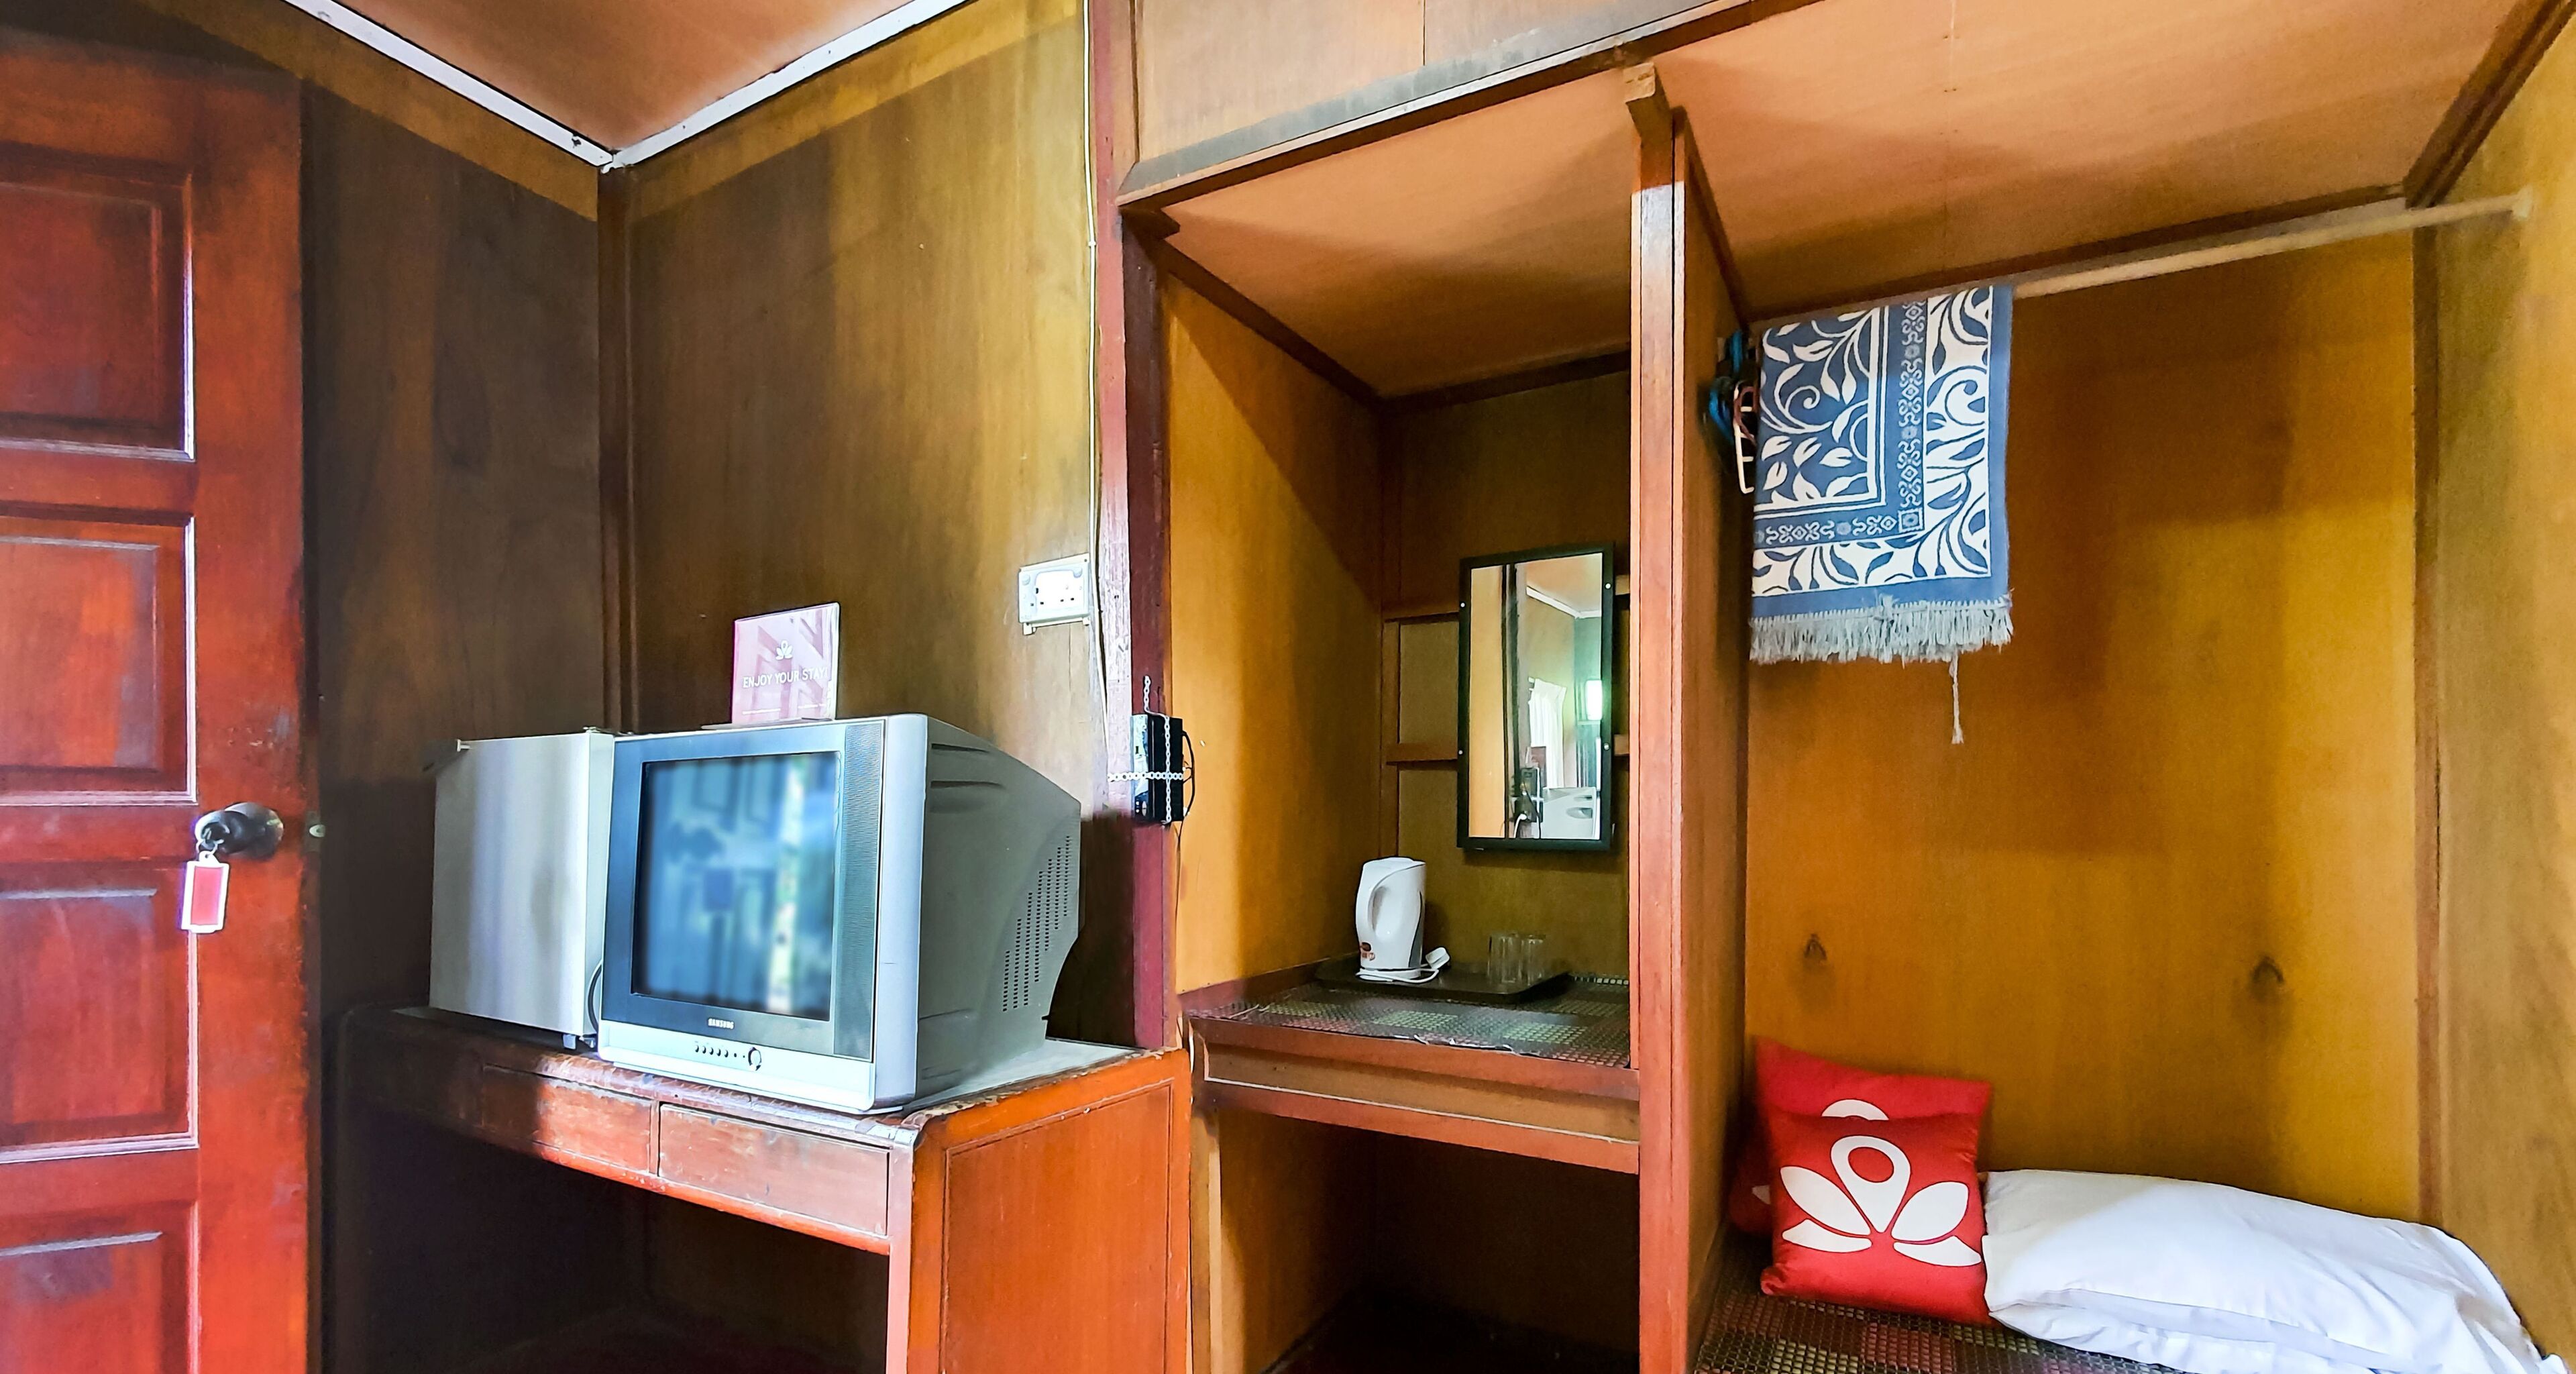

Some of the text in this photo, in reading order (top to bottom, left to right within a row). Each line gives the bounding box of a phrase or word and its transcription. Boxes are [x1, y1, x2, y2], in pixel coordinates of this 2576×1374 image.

[743, 674, 772, 688] ENJOY
[775, 671, 799, 684] YOUR
[708, 1018, 734, 1029] SAMSUNG
